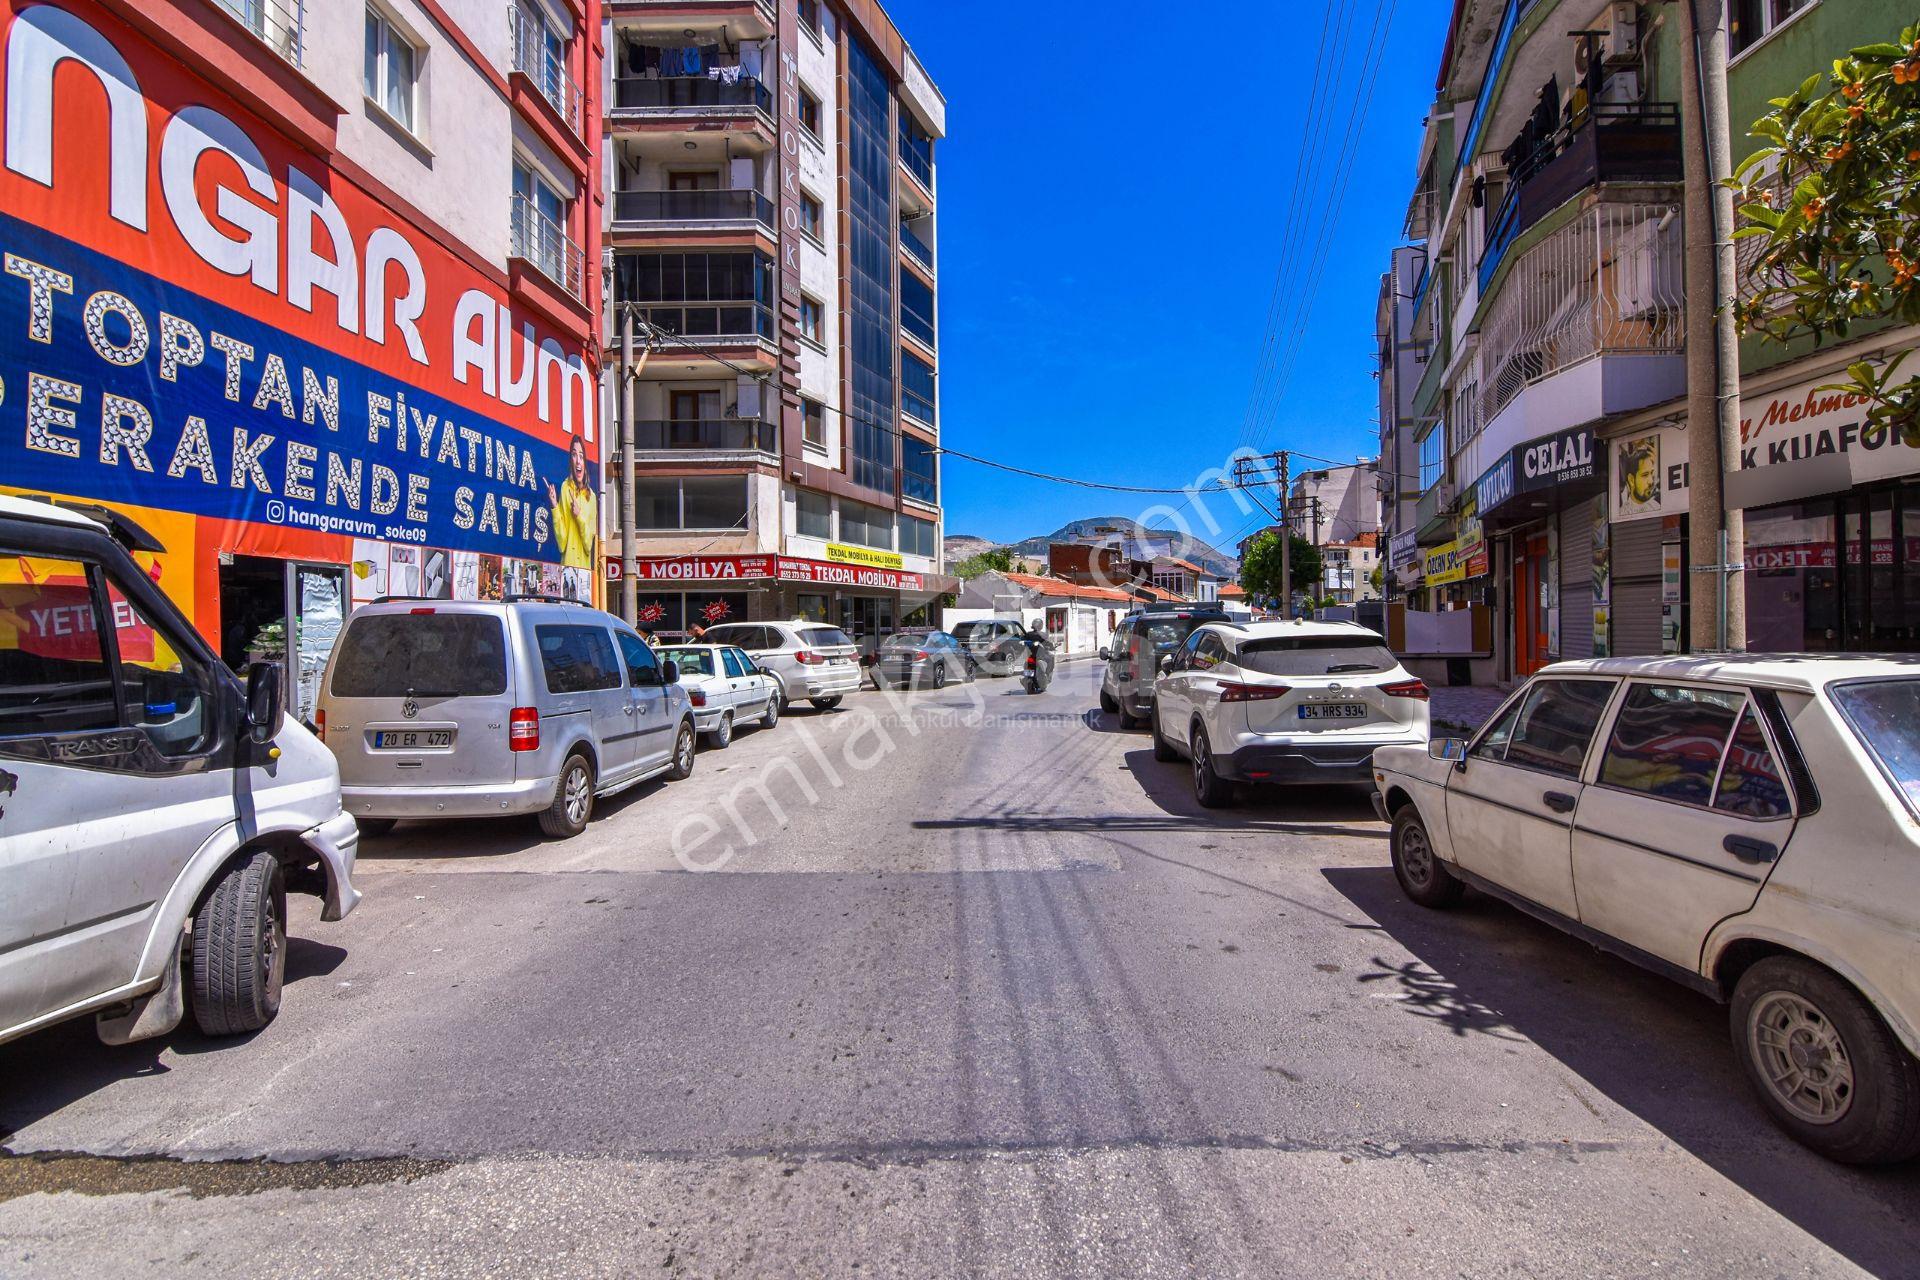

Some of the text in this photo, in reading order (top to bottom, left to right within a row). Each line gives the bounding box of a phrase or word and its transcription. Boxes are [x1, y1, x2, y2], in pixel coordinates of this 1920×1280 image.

[4, 252, 538, 490] TOPTAN FİYATINA
[0, 371, 549, 550] ERAKENDE SATIŞ
[1524, 433, 1592, 478] CELAL
[288, 507, 427, 542] hangaravm_soke09
[828, 547, 847, 558] TEKDAL
[650, 557, 737, 579] MOBİLYA
[814, 565, 897, 588] TEKDAL MOBİLYA
[30, 597, 147, 638] YETİEN
[1305, 705, 1364, 717] 34 HRS 934
[384, 733, 447, 746] 20 ER 472
